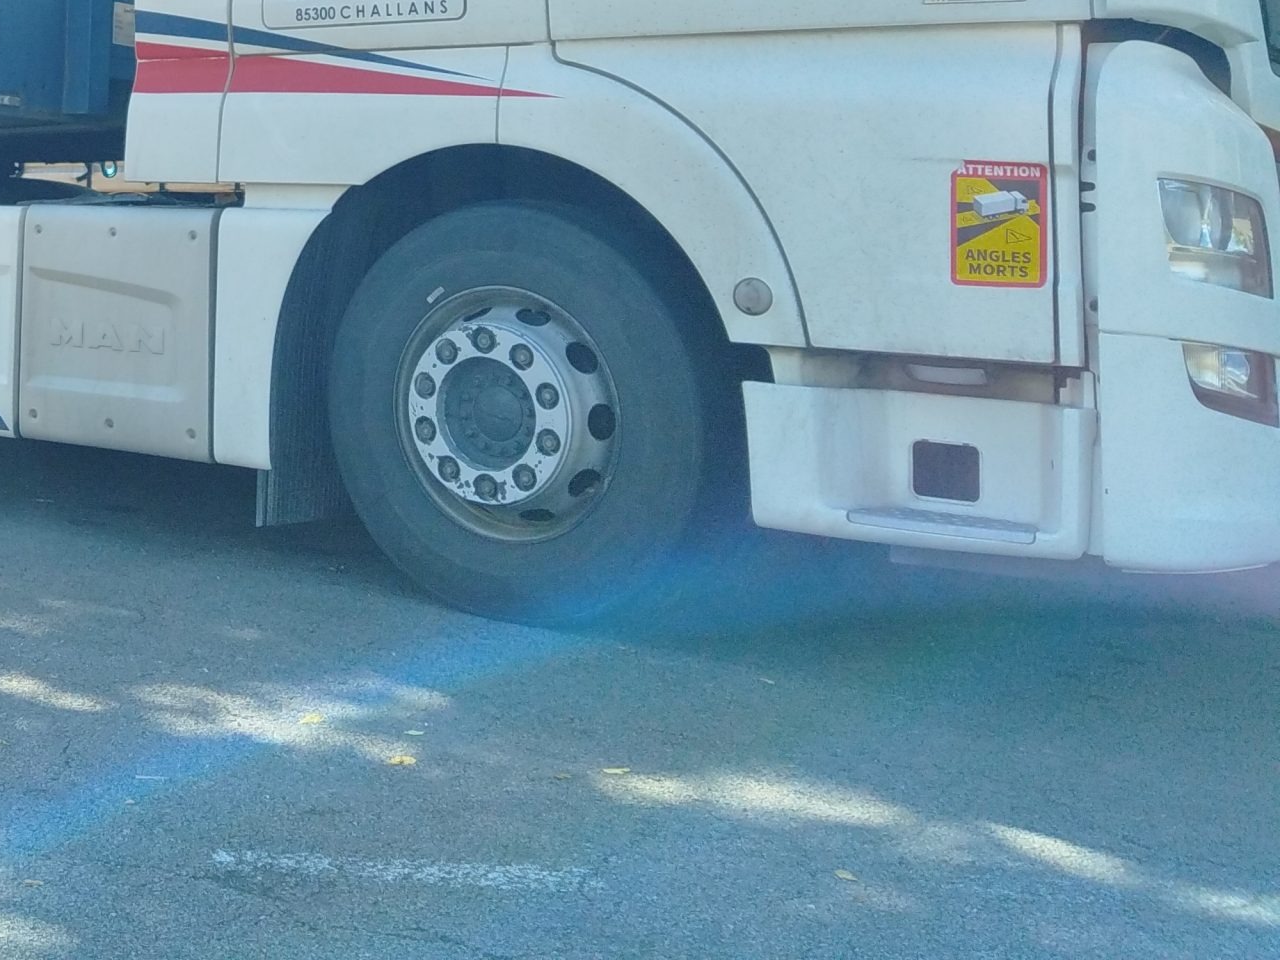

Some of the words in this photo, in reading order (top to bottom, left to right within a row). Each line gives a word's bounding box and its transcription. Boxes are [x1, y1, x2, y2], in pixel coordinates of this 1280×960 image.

[295, 6, 337, 21] 85300
[340, 0, 449, 19] CHALLANS
[957, 164, 1041, 177] ATTENTION
[965, 249, 1032, 263] ANGLES
[968, 263, 1029, 277] MORTS
[49, 318, 165, 356] MAN
